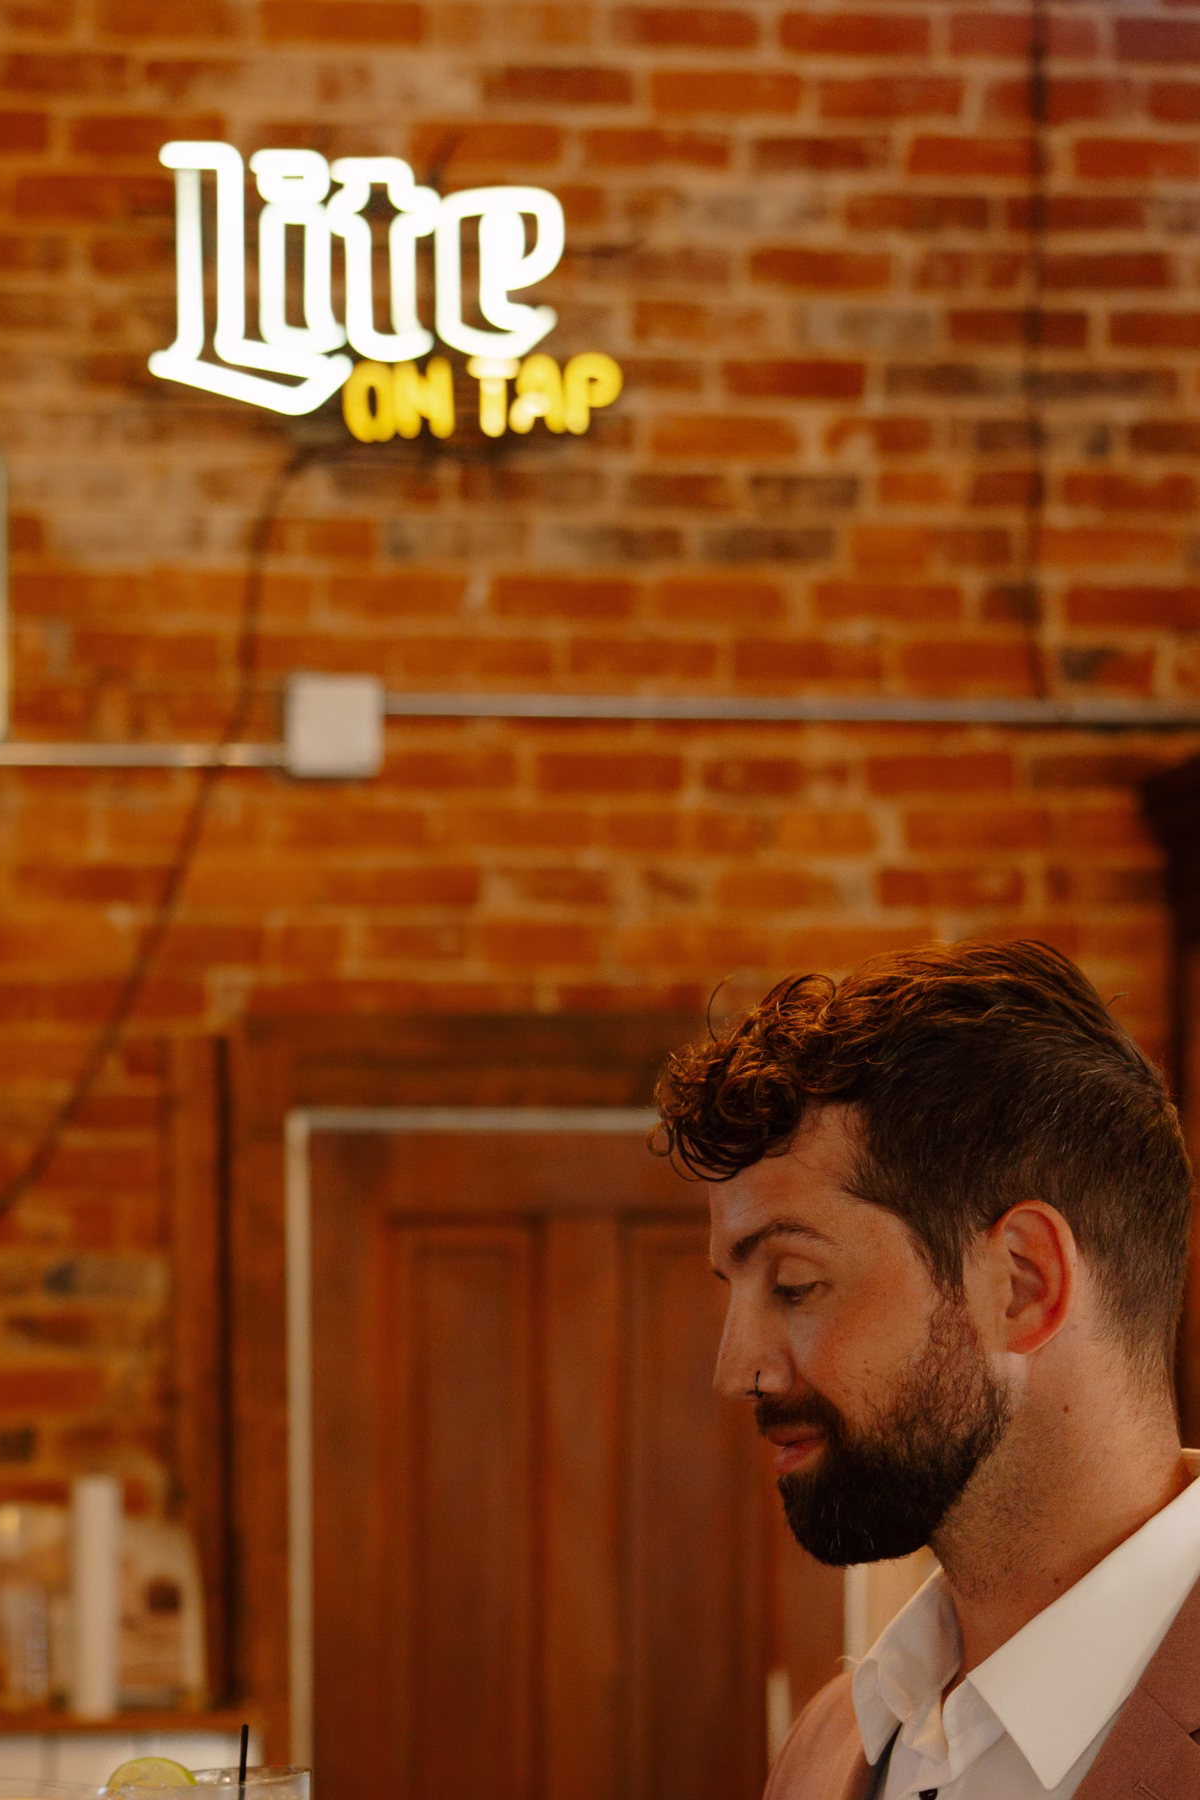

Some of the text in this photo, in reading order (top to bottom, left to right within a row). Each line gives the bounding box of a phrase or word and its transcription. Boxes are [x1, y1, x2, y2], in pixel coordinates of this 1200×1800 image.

[147, 140, 565, 415] Lite
[342, 352, 623, 443] ON TAP
